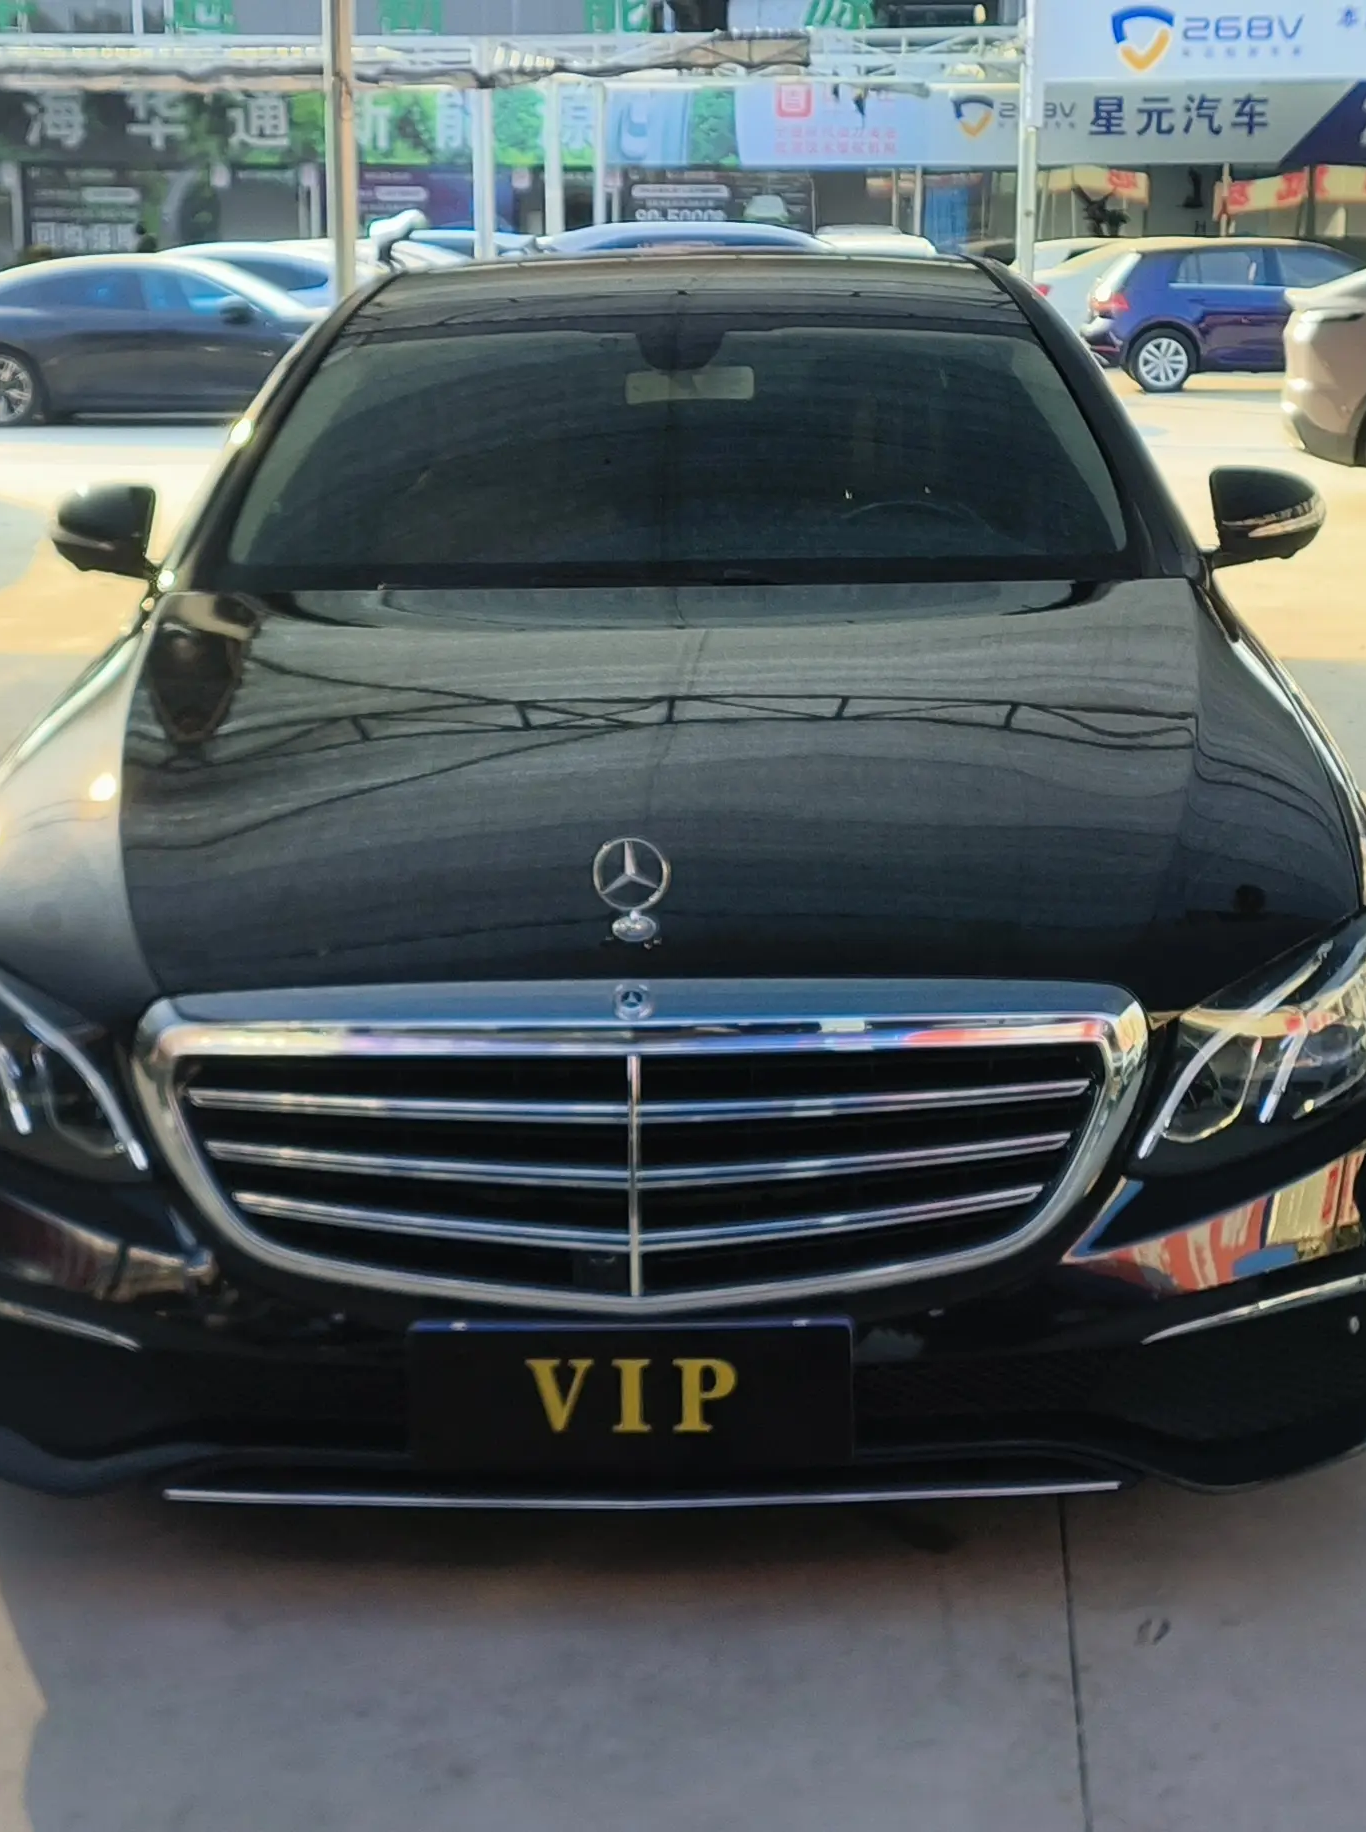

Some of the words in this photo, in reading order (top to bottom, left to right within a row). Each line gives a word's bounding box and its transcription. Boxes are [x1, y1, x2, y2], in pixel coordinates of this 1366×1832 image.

[1182, 14, 1305, 42] 268V
[1089, 95, 1270, 137] 星元汽车
[525, 1358, 738, 1433] VIP
